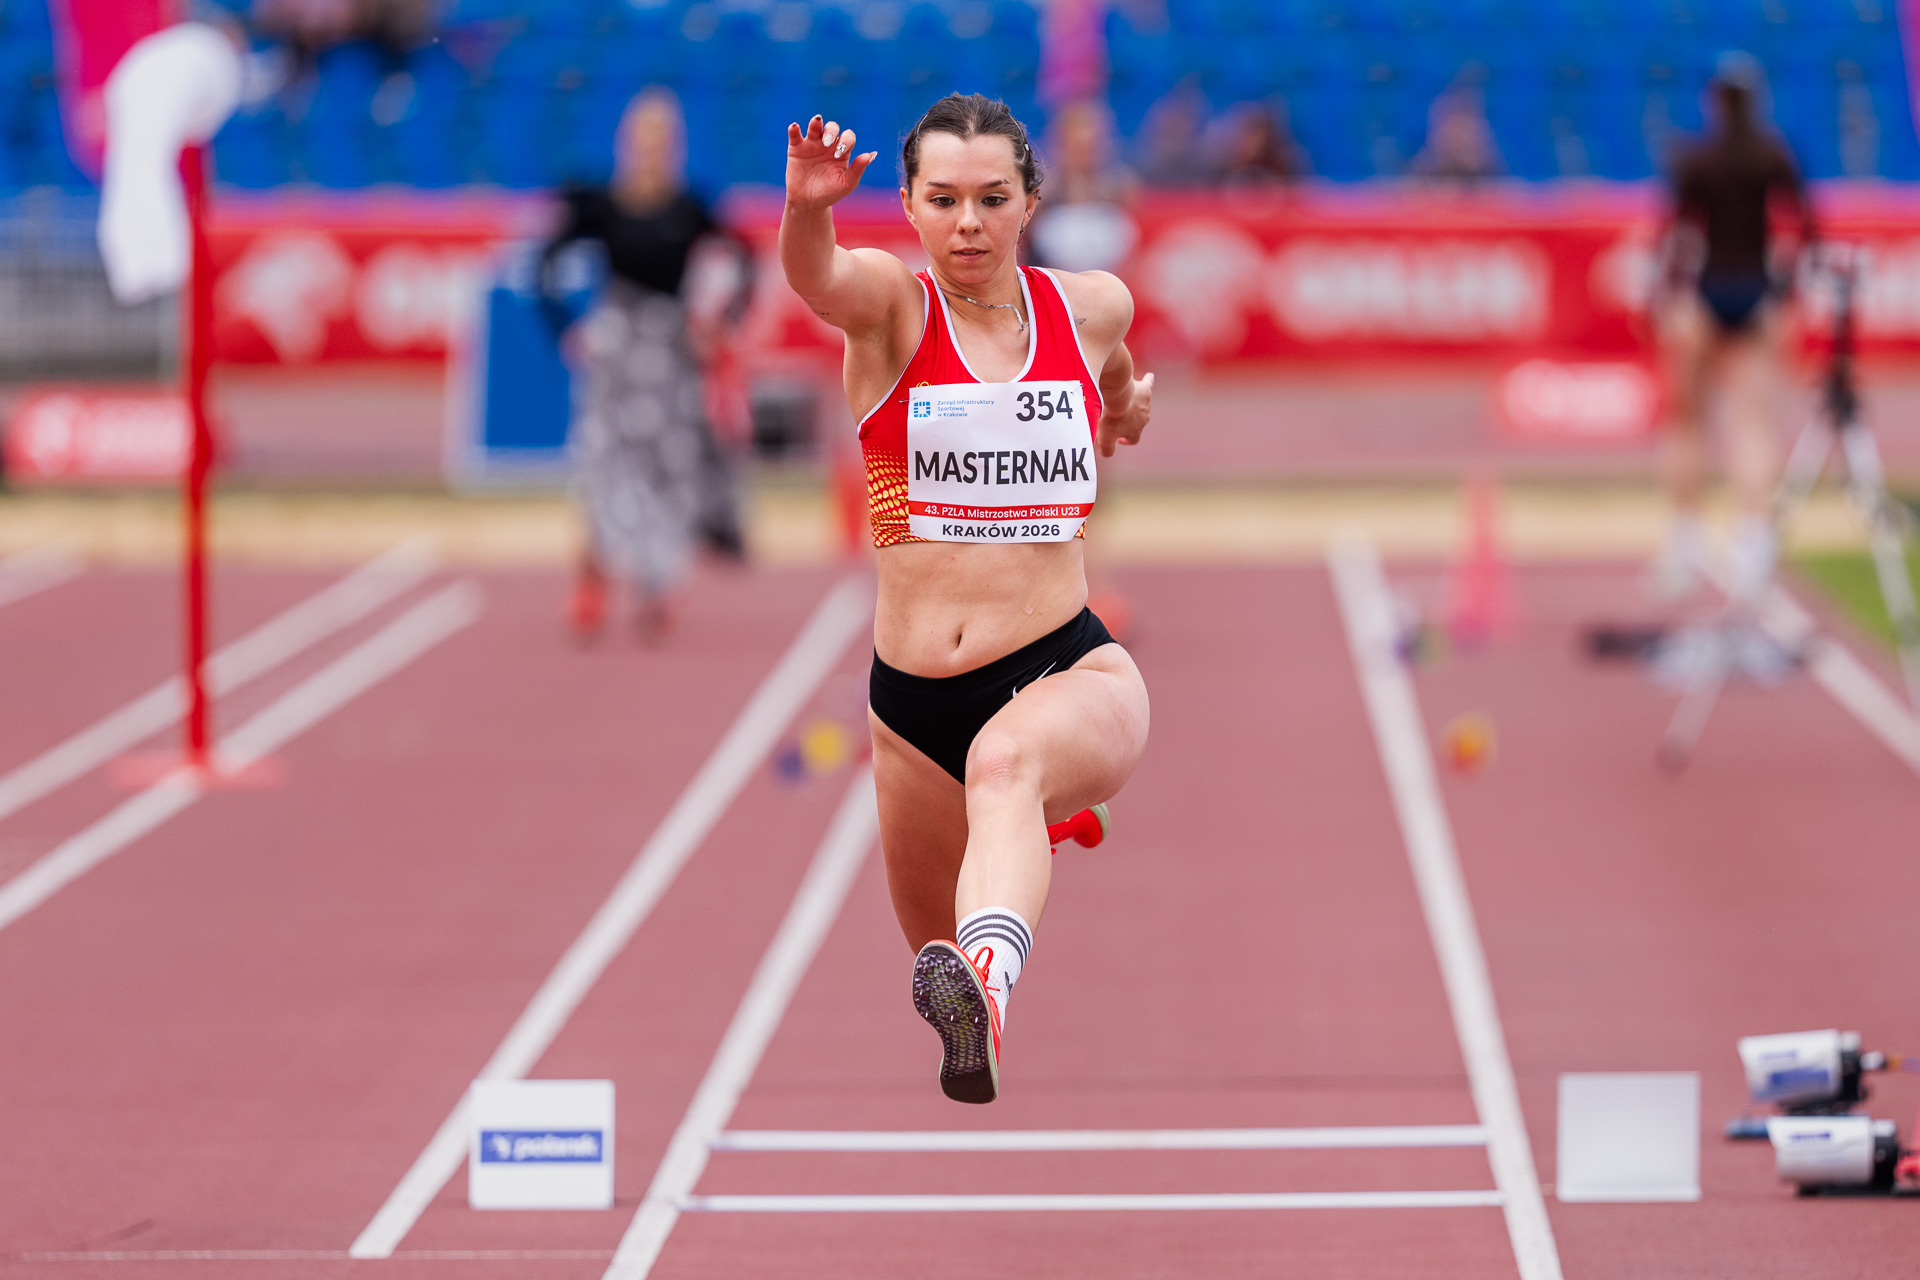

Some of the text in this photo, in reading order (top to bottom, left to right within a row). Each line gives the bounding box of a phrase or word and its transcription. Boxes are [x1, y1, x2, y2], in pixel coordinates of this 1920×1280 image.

[1015, 390, 1074, 422] 354
[914, 447, 1090, 485] MASTERNAK
[924, 504, 1080, 519] 43. PZLA Mistrzostwa Polski U23
[942, 523, 1061, 538] KRAKÓW 2026
